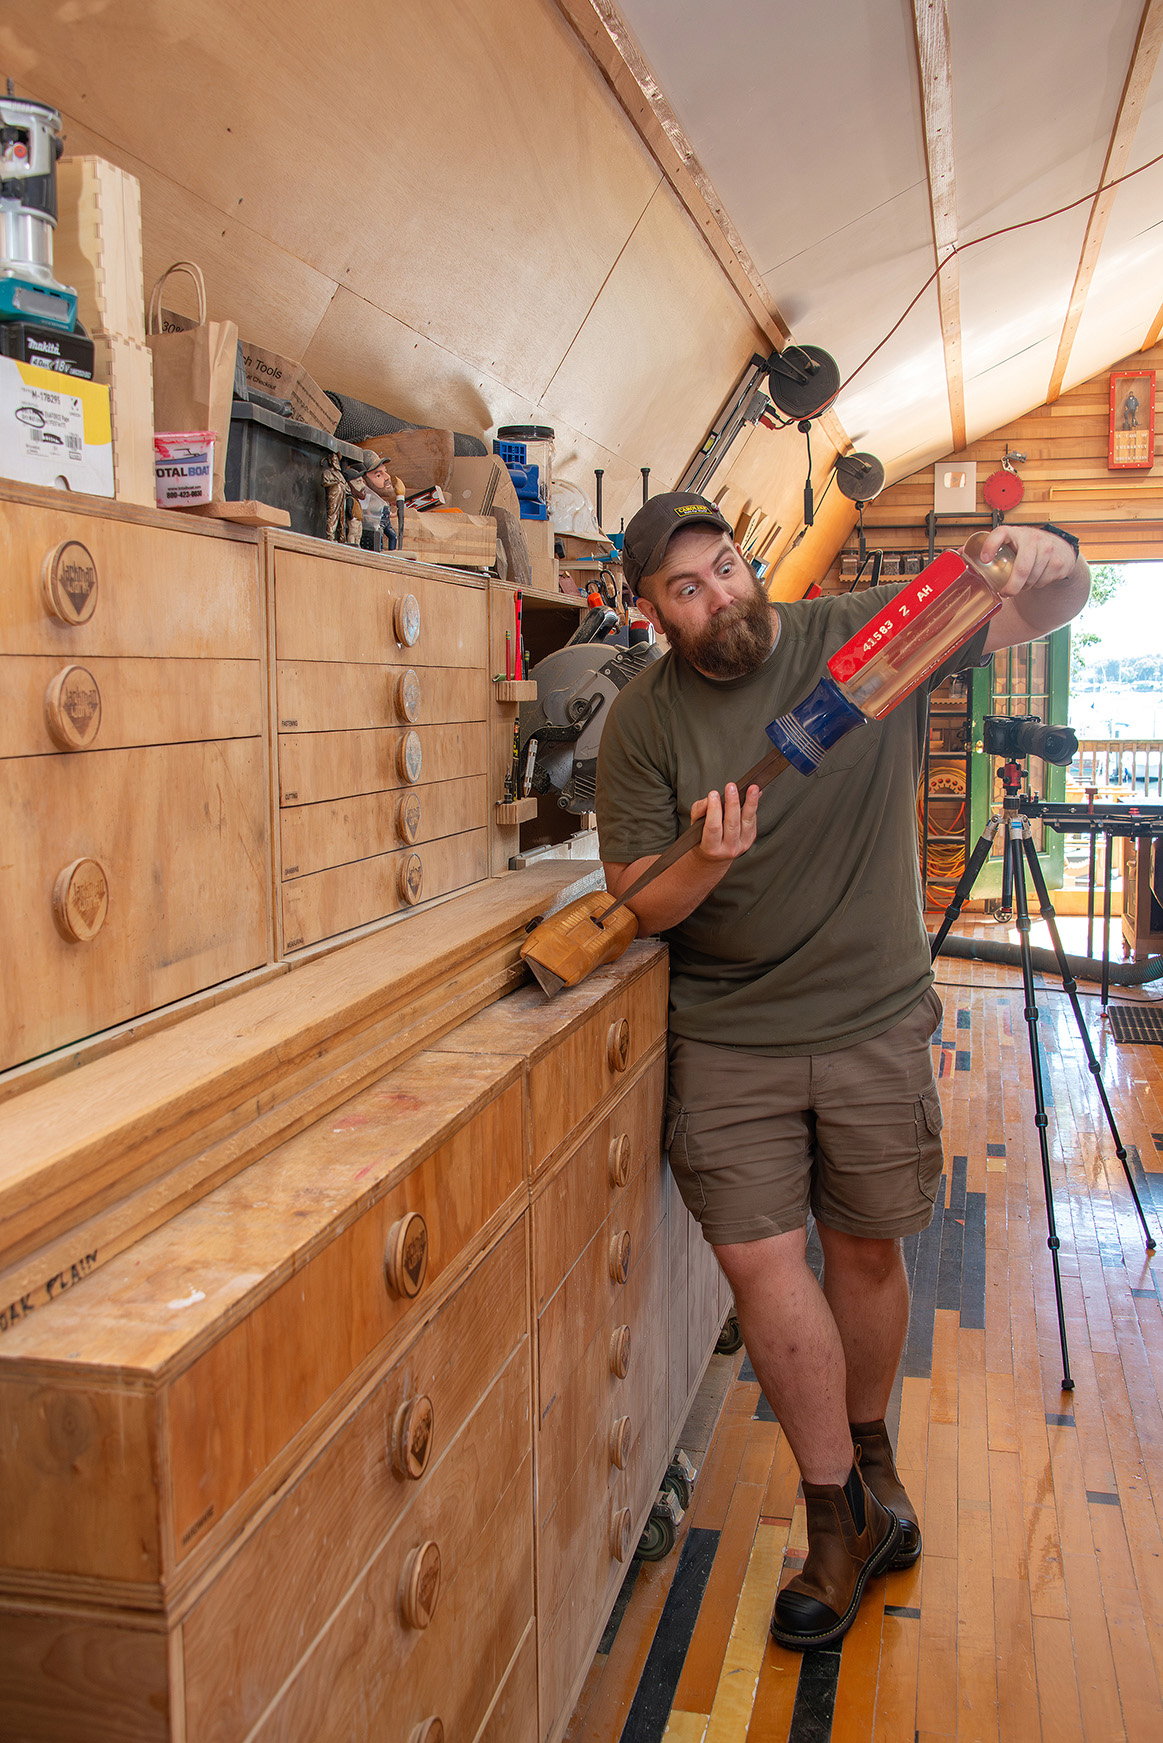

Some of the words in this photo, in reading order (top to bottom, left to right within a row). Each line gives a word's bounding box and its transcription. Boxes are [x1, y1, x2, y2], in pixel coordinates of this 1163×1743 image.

[27, 337, 61, 356] makita
[256, 359, 283, 380] Tools
[252, 376, 277, 391] Checkout
[155, 465, 210, 478] OTALBOAT
[863, 620, 894, 652] 41583
[916, 584, 934, 602] AH
[45, 1248, 98, 1302] PLAIN
